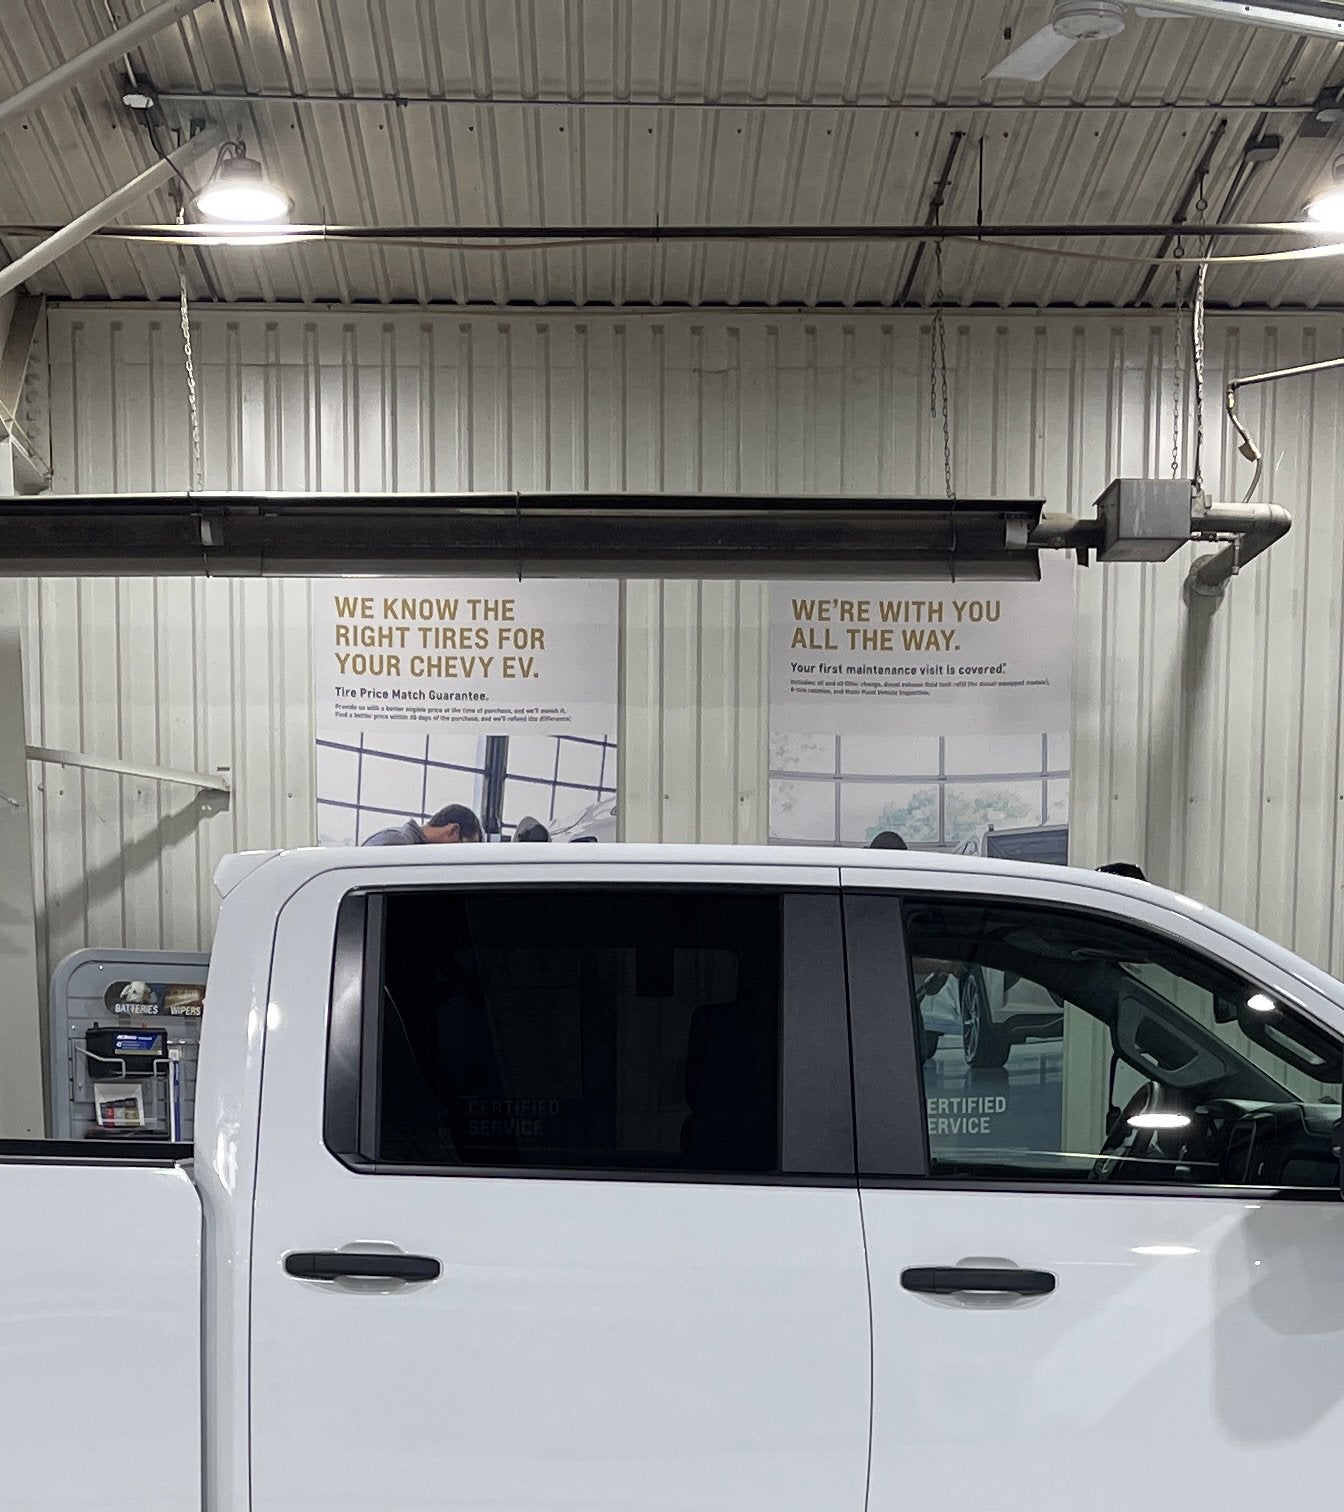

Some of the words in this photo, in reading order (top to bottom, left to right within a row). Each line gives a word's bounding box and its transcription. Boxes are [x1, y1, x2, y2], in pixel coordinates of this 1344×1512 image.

[334, 596, 374, 619] WE
[382, 598, 459, 621] KNOW
[467, 599, 515, 622] THE
[791, 599, 871, 622] WE'RE
[878, 600, 944, 623] WITH
[952, 600, 1001, 622] YOU
[334, 624, 410, 649] RIGHT
[417, 626, 490, 650] TIRES
[498, 627, 545, 650] FOR
[791, 628, 838, 650] ALL
[846, 628, 894, 651] THE
[902, 629, 961, 651] WAY.
[334, 652, 401, 676] YOUR
[410, 654, 494, 679] CHEVY
[502, 656, 540, 679] EV.
[791, 662, 815, 675] Your
[819, 662, 843, 675] first
[846, 663, 917, 676] maintenance
[920, 664, 943, 675] visit
[946, 664, 956, 675] is
[335, 686, 357, 698] Tire
[360, 687, 388, 699] Price
[392, 688, 425, 701] Match
[428, 689, 490, 702] Guarantee.
[115, 1003, 159, 1015] BATTERIES
[171, 1005, 201, 1016] WIPERS
[927, 1097, 1006, 1114] ERTIFIED
[928, 1117, 991, 1134] ERVICE
